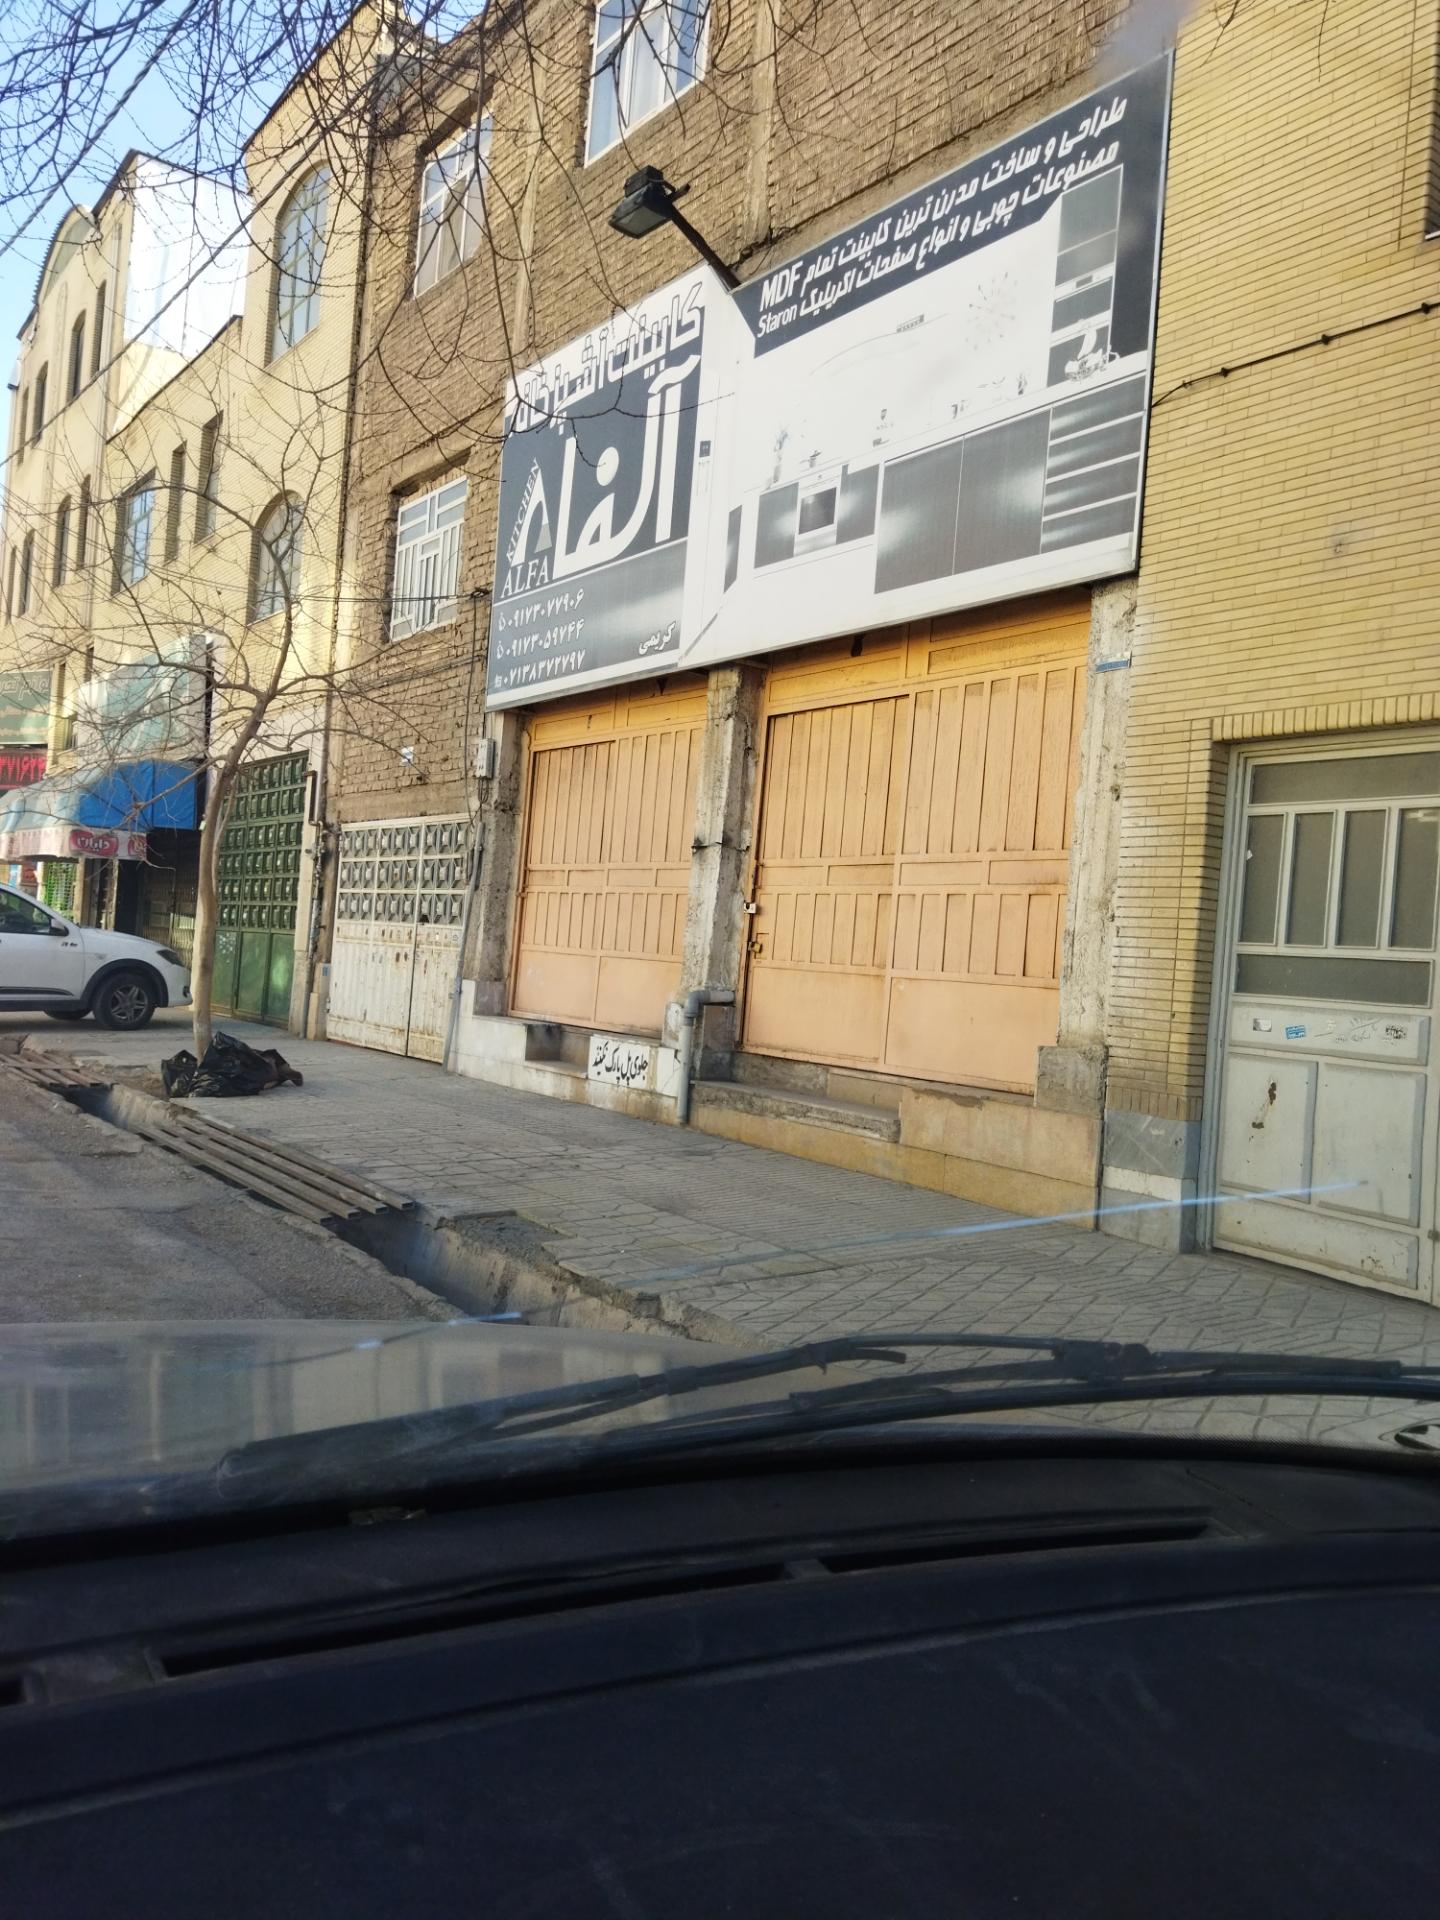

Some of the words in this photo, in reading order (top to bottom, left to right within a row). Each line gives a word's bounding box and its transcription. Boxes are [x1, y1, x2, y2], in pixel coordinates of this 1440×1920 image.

[1058, 96, 1127, 158] طراحی
[981, 145, 1042, 191] ساخت
[1021, 141, 1120, 206] مصنوعات
[1044, 137, 1056, 164] و
[894, 195, 933, 241] ترین
[932, 177, 979, 221] مدرن
[972, 191, 1020, 237] چوبی
[838, 217, 892, 262] کابینت
[916, 214, 960, 270] انواع
[959, 214, 971, 242] و
[759, 261, 803, 312] MDF
[800, 246, 839, 298] تمام
[856, 243, 917, 289] صفحات
[800, 268, 857, 316] اکریلیک
[607, 281, 706, 382] کابینت
[757, 304, 797, 338] Staron
[506, 457, 540, 564] KITCHEN
[501, 555, 551, 599] ALFA
[638, 621, 677, 655] کریمی
[604, 1045, 621, 1088] پارک
[620, 1049, 632, 1087] پل
